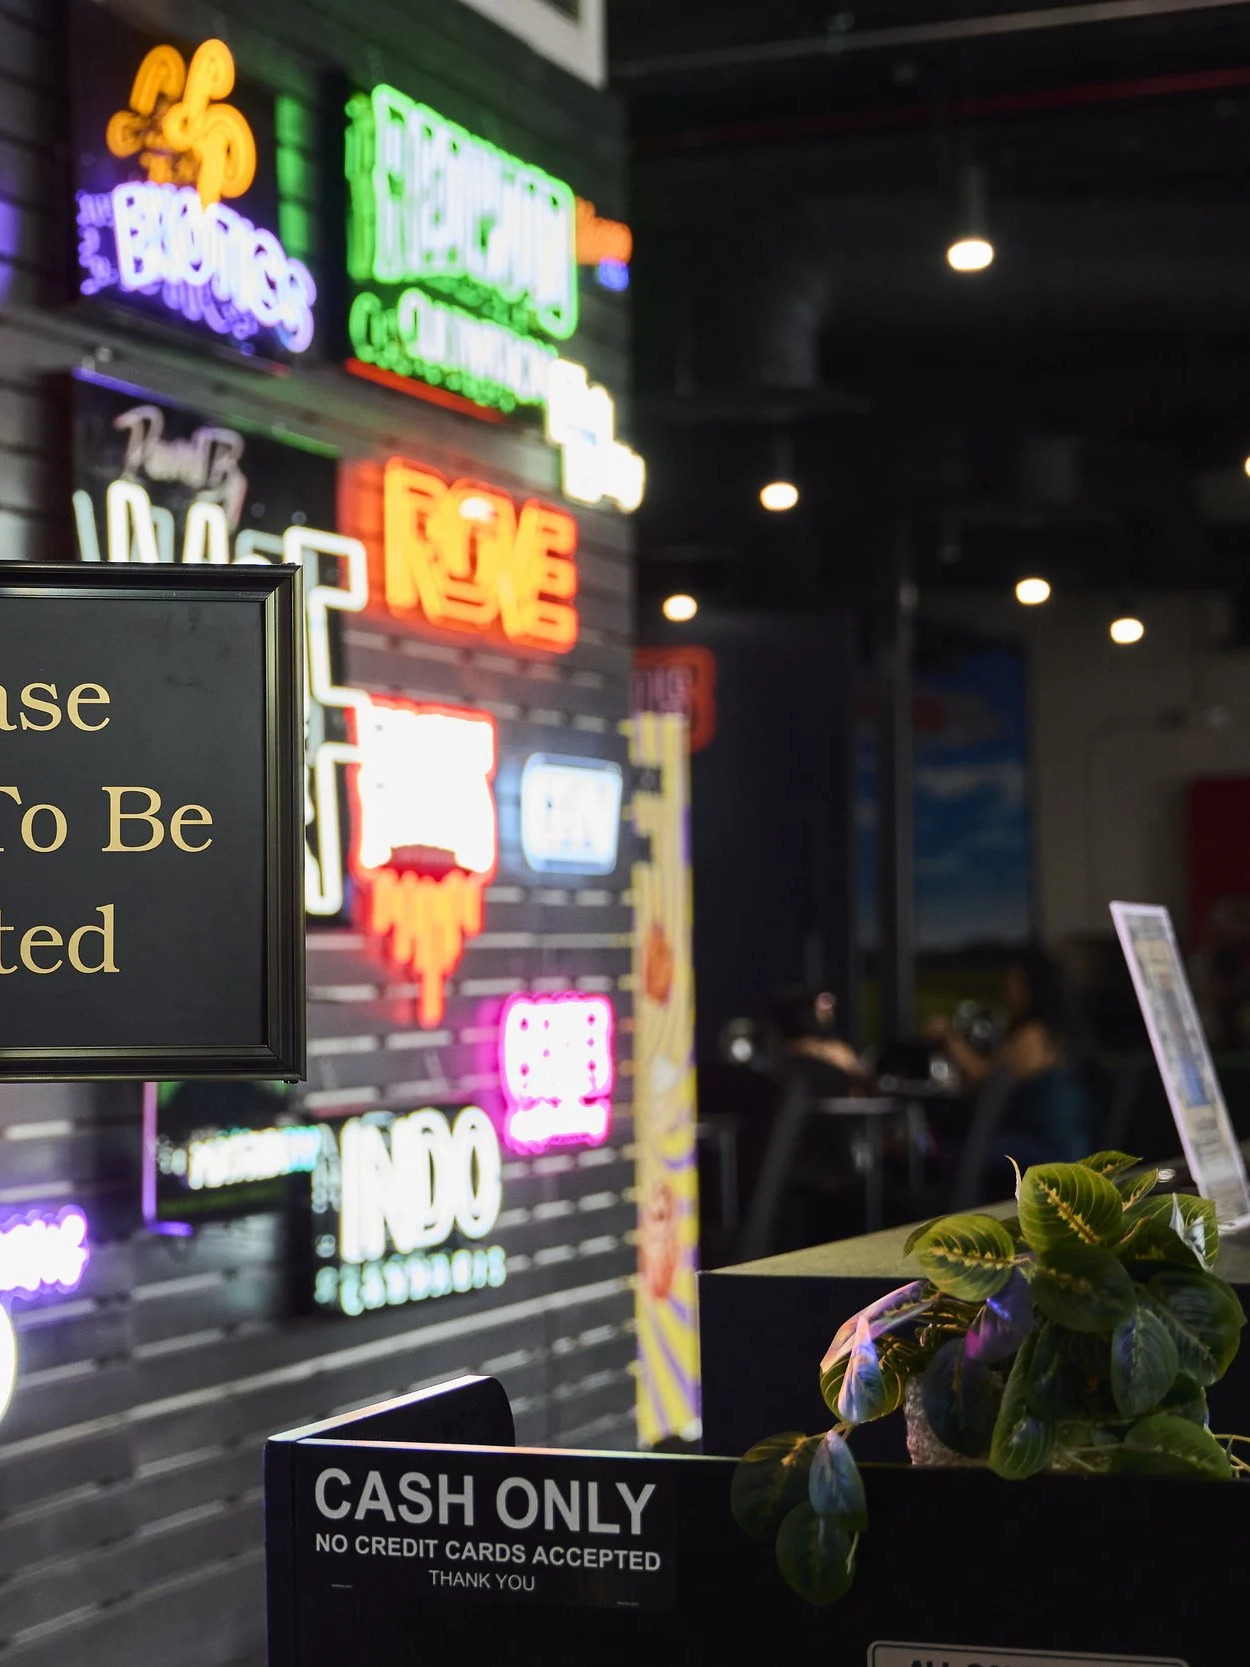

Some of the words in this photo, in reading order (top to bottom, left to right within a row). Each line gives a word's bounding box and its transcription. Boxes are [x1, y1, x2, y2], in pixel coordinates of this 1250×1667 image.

[101, 786, 213, 853] Be
[339, 1105, 502, 1264] INDO
[314, 1467, 475, 1526] CASH
[495, 1476, 656, 1535] ONLY
[315, 1532, 349, 1554] NO
[354, 1535, 439, 1559] CREDIT
[445, 1540, 526, 1563] CARDS
[531, 1545, 661, 1571] ACCEPTED
[428, 1569, 491, 1588] THANK
[495, 1573, 535, 1591] YOU
